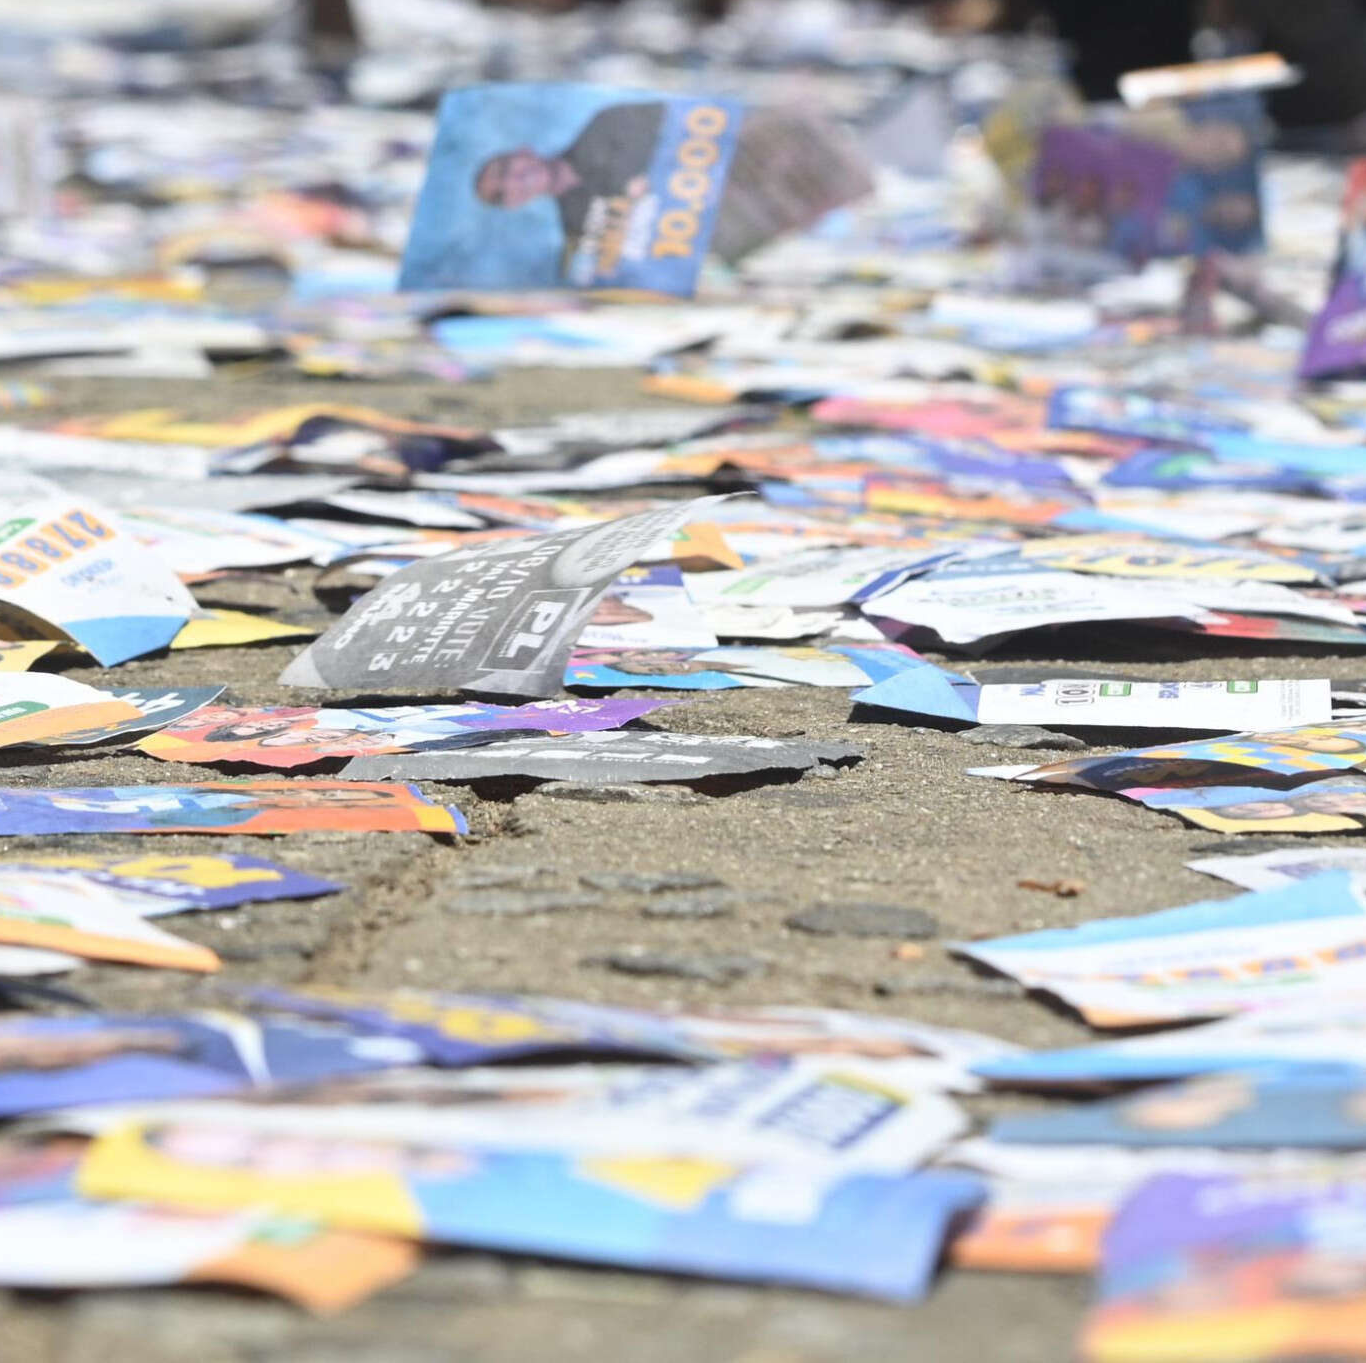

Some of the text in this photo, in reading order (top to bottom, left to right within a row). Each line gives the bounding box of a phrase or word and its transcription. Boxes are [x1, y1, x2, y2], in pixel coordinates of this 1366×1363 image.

[652, 106, 727, 258] 10.000
[411, 588, 480, 665] MARIOTTE
[507, 602, 567, 658] PL
